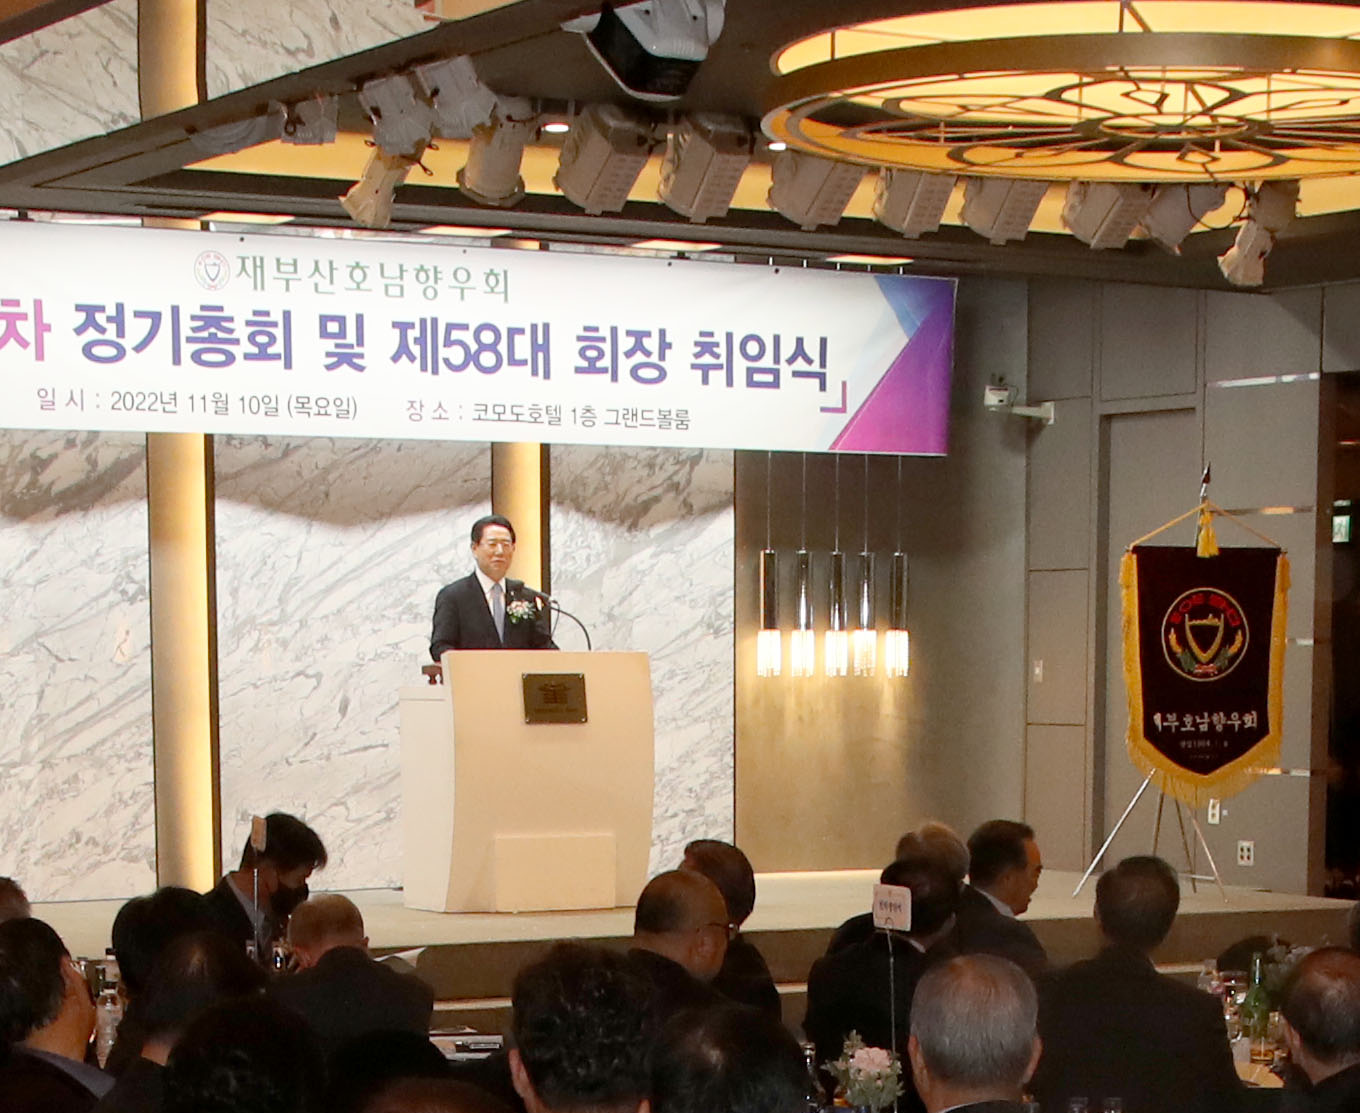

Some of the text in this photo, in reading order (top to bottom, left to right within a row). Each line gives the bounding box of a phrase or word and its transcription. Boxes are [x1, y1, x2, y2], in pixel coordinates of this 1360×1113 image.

[236, 254, 510, 304] 재부산호남향우회
[72, 301, 294, 370] 정기총회
[318, 311, 368, 374] 및
[390, 316, 552, 381] 제58대
[574, 324, 674, 384] 회장
[109, 390, 179, 414] 2022년
[187, 392, 230, 416] 11월
[238, 394, 280, 418] 10일
[286, 394, 359, 421] (목요일)
[471, 402, 563, 427] 코모도호텔
[570, 406, 598, 429] 1층
[603, 408, 692, 431] 그랜드볼룸
